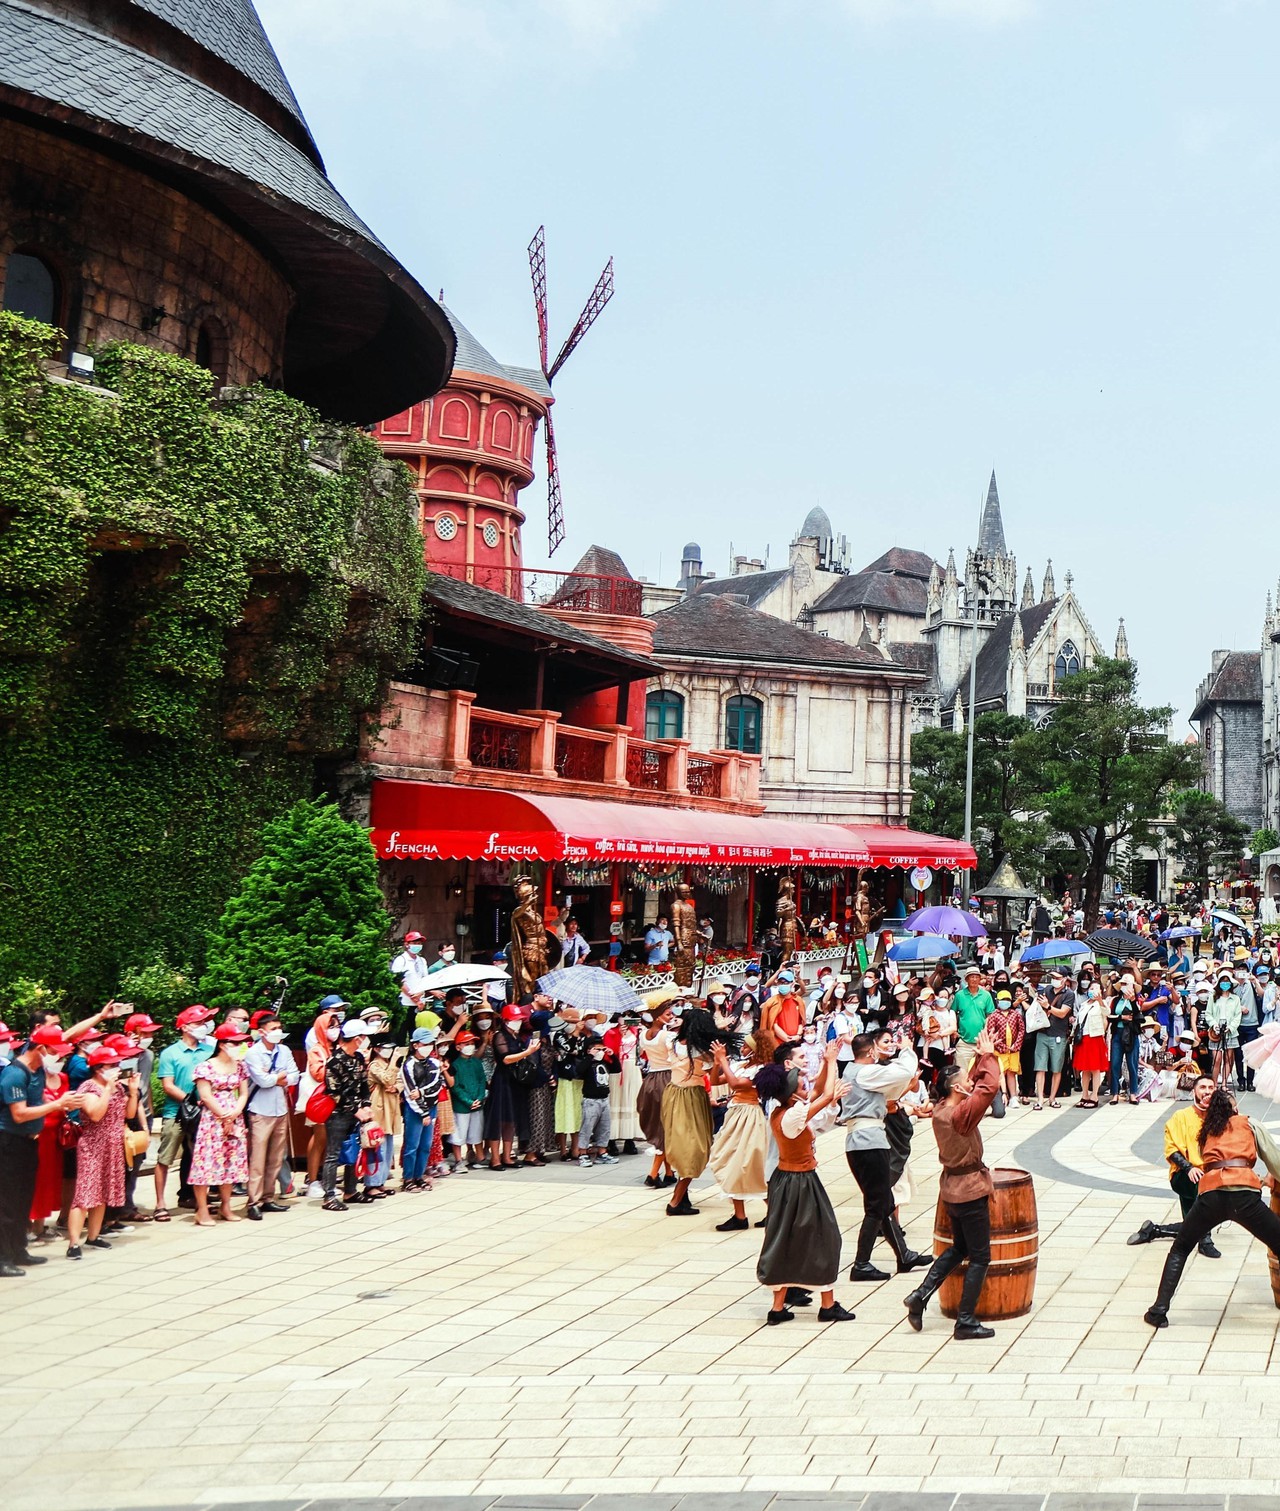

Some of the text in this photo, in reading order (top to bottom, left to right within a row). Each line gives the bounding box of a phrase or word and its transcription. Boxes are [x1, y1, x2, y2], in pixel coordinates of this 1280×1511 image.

[394, 844, 438, 853] FENCHA
[494, 845, 538, 855] FENCHA
[889, 856, 919, 864] COFFEE
[935, 857, 957, 865] JUICE
